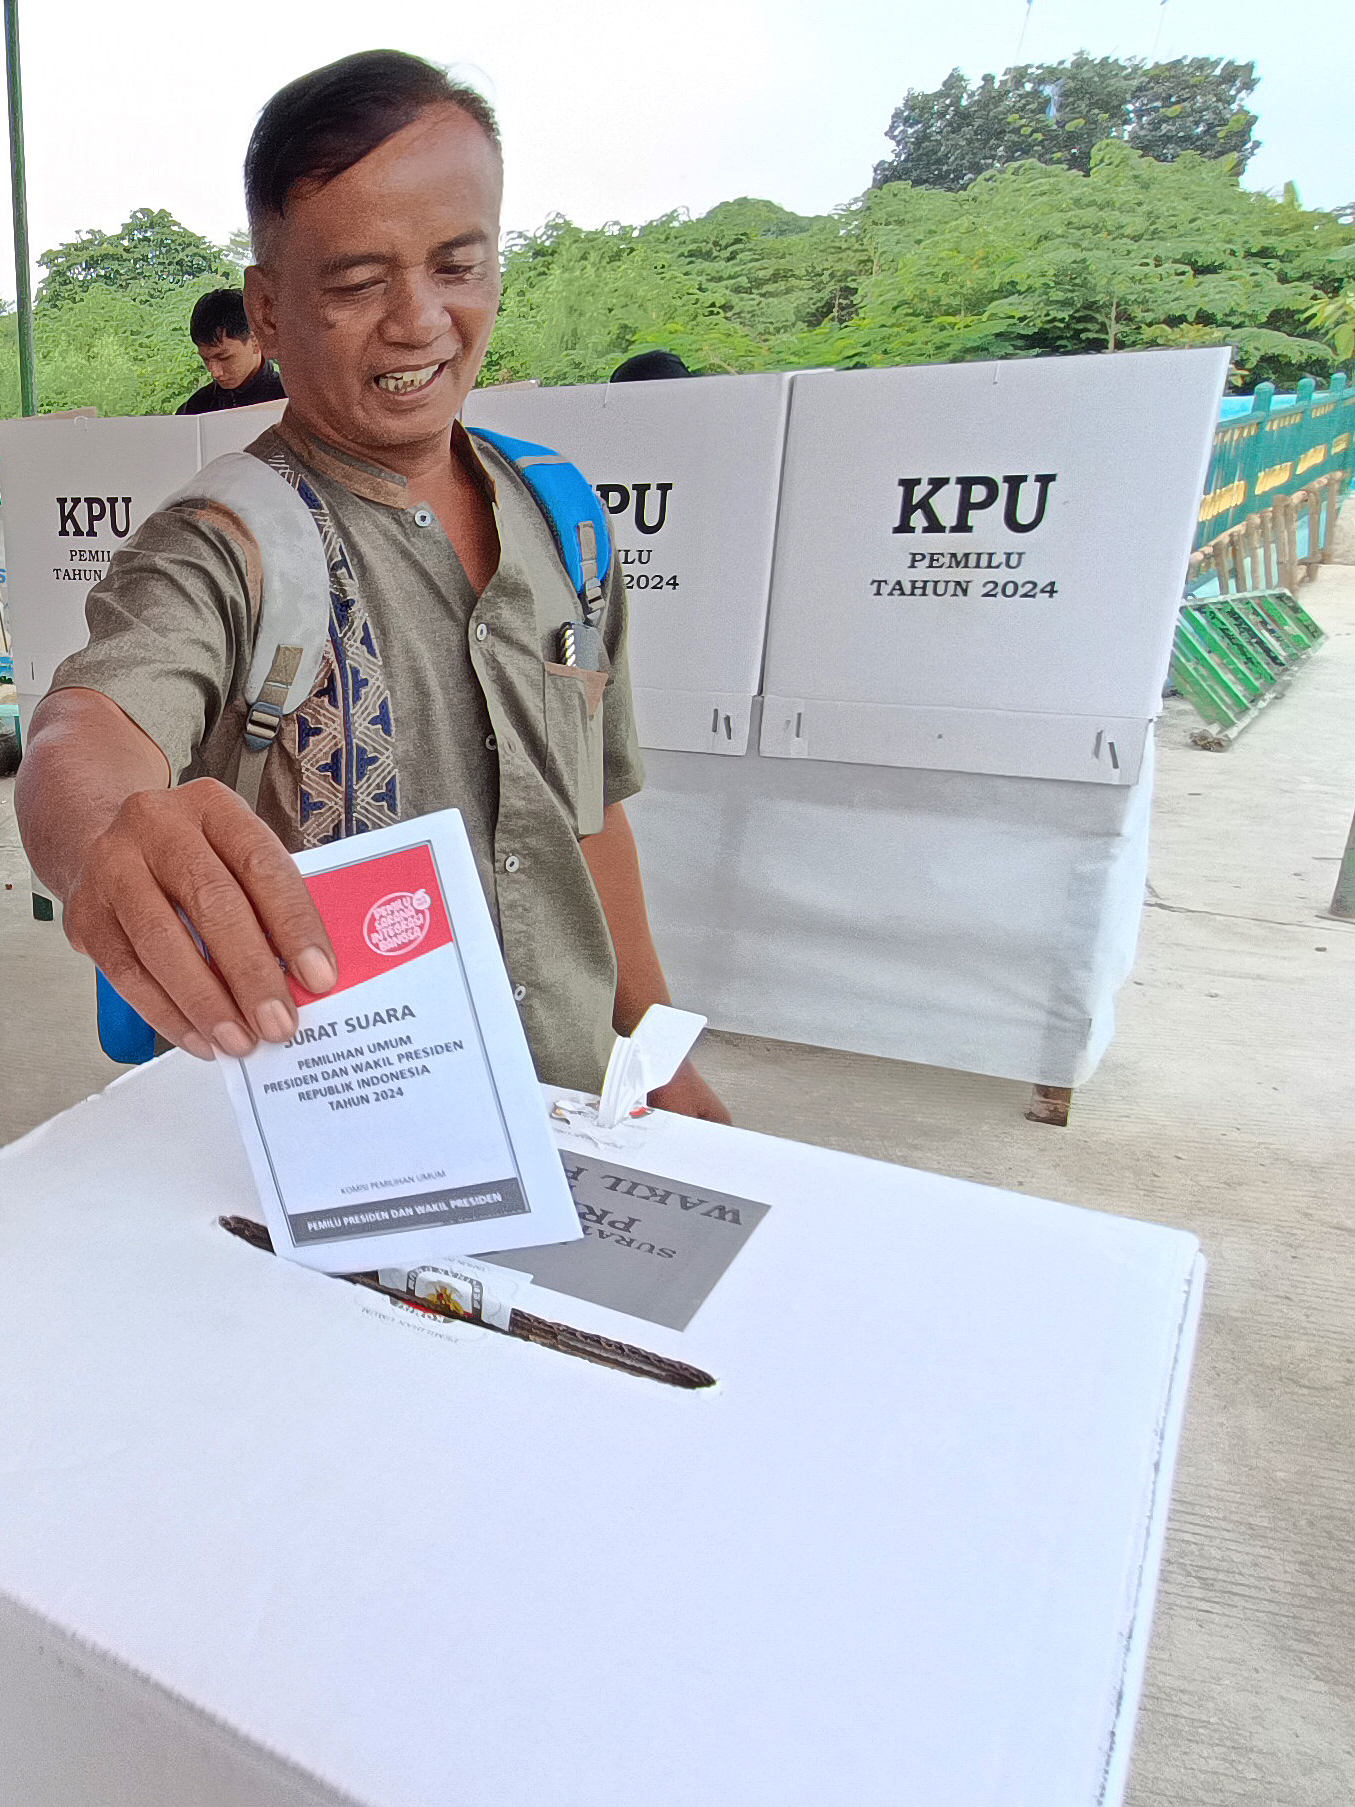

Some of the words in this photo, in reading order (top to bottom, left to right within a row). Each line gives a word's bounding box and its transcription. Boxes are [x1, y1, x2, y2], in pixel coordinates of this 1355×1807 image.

[56, 496, 132, 538] KPU
[596, 483, 673, 535] PU
[892, 473, 1058, 535] KPU
[69, 549, 111, 563] PEMI
[907, 552, 1026, 570] PEMILU
[53, 568, 102, 582] TAHUN
[623, 574, 680, 591] 2024
[869, 579, 973, 598] TAHUN
[981, 580, 1059, 599] 2024
[344, 1004, 417, 1034] SUARA
[263, 1073, 319, 1095] PRESIDEN
[321, 1066, 349, 1082] DAN
[351, 1056, 395, 1075] WAKIL
[397, 1039, 465, 1064] PRESIDEN
[297, 1046, 365, 1071] PEMILIHAN
[367, 1034, 413, 1054] UMUM
[297, 1081, 354, 1102] REPUBLIK
[357, 1064, 432, 1089] INDONESIA
[328, 1094, 370, 1111] TAHUN
[373, 1086, 405, 1103] 2024
[307, 1219, 342, 1233] PEMILU
[344, 1211, 390, 1226] PRESIDEN
[391, 1206, 414, 1219] DAN
[415, 1202, 449, 1216] WAKIL
[451, 1192, 503, 1209] PRESIDEN
[601, 1174, 742, 1226] WAKIL
